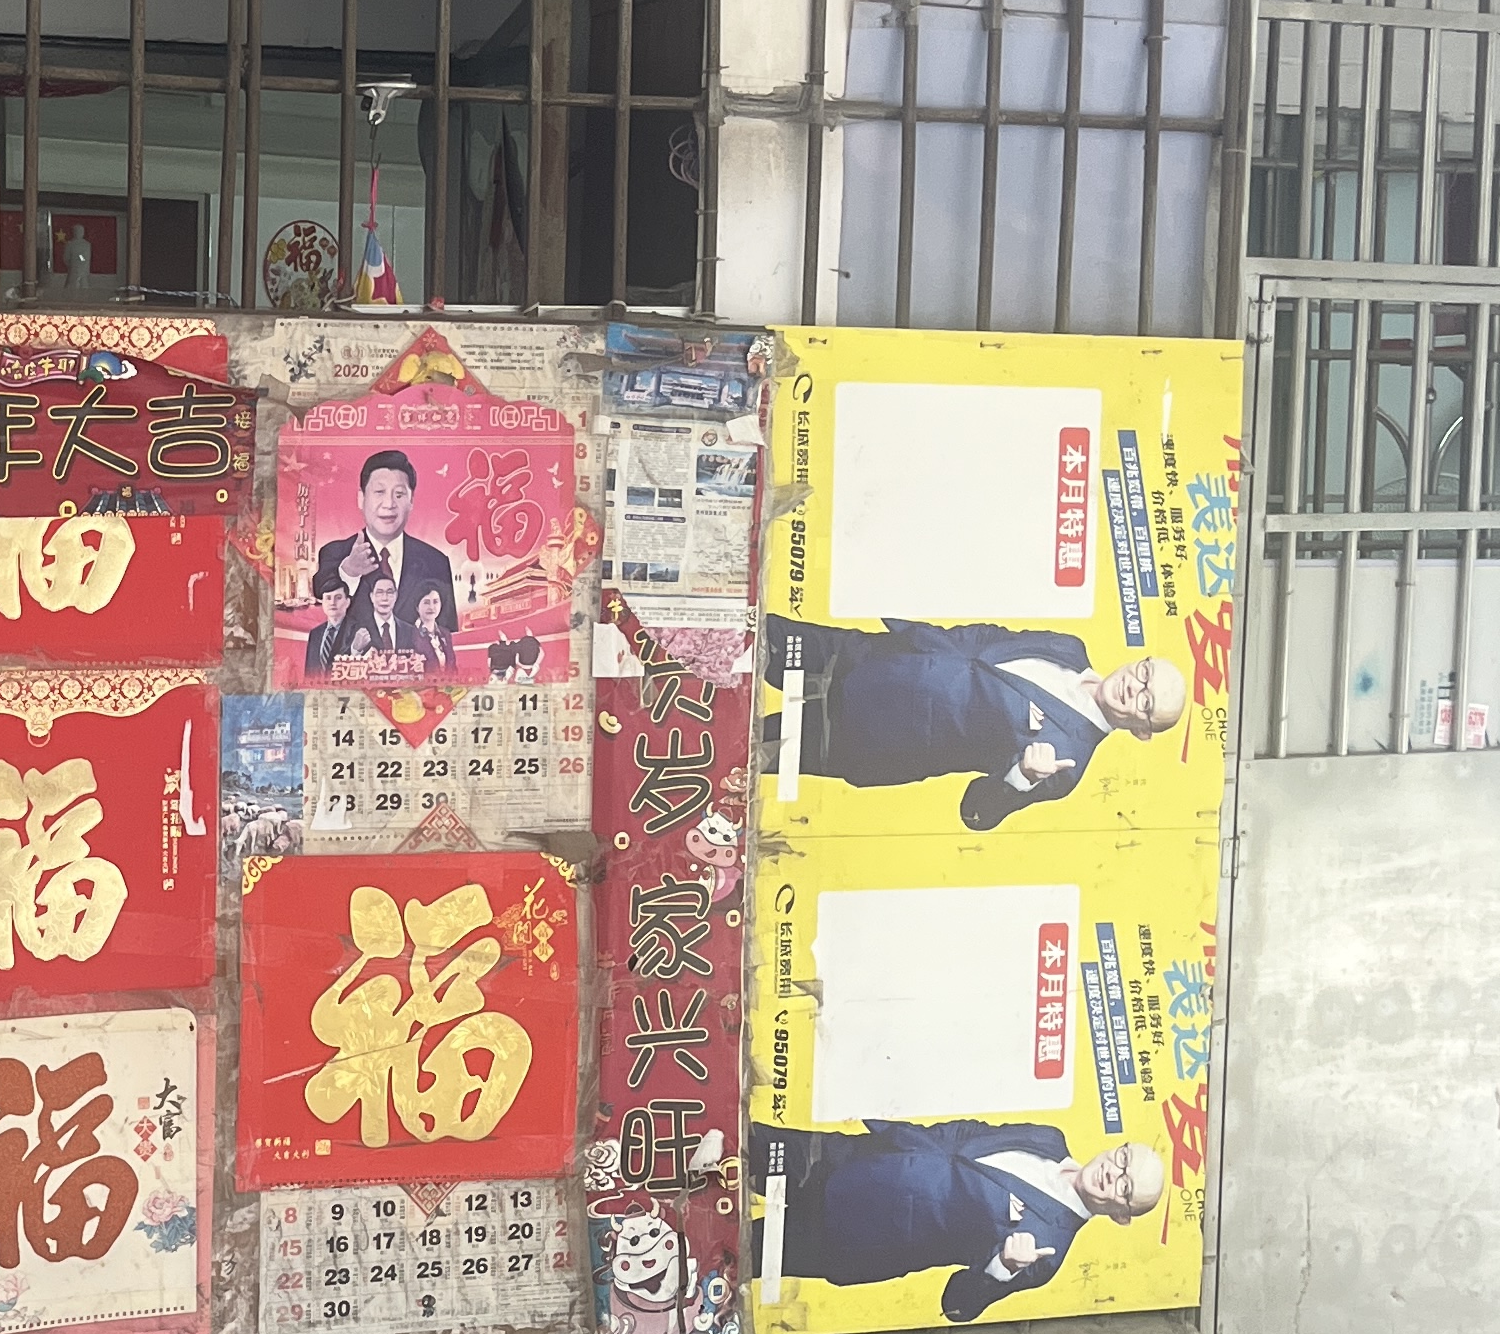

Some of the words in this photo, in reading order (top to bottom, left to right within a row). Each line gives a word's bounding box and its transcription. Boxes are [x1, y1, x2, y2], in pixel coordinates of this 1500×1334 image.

[285, 227, 320, 273] 福
[334, 363, 370, 378] 2020
[574, 443, 587, 460] 8
[444, 446, 545, 561] 福
[1057, 443, 1088, 573] 本月特惠
[789, 519, 806, 582] 95079
[1151, 489, 1179, 616] 价格低、体验爽
[337, 696, 351, 715] 7
[470, 694, 495, 712] 10
[517, 693, 539, 711] 11
[561, 692, 584, 710] 12
[331, 729, 355, 747] 14
[378, 728, 401, 747] 15
[470, 726, 494, 745] 17
[515, 725, 539, 743] 18
[561, 724, 583, 743] 19
[1200, 708, 1218, 742] ONE
[331, 761, 356, 780] 21
[376, 761, 403, 779] 22
[422, 760, 449, 778] 23
[468, 758, 495, 776] 24
[513, 757, 540, 775] 25
[559, 756, 585, 775] 26
[375, 793, 403, 811] 29
[304, 883, 533, 1149] 福
[1038, 939, 1067, 1064] 本月特惠
[1128, 979, 1156, 1103] 价格低、体验爽
[772, 1028, 789, 1090] 95079
[284, 1207, 298, 1224] 8
[331, 1203, 345, 1221] 9
[372, 1200, 396, 1218] 10
[464, 1193, 488, 1212] 12
[509, 1190, 533, 1209] 13
[1180, 1189, 1197, 1222] ONE
[279, 1239, 303, 1257] 15
[325, 1236, 350, 1254] 16
[372, 1232, 396, 1250] 17
[418, 1229, 442, 1247] 18
[463, 1225, 487, 1243] 19
[507, 1222, 534, 1241] 20
[276, 1273, 304, 1290] 22
[323, 1268, 351, 1287] 23
[369, 1264, 397, 1283] 24
[415, 1261, 444, 1279] 25
[461, 1257, 489, 1276] 26
[506, 1253, 534, 1272] 27
[276, 1303, 304, 1323] 29
[322, 1300, 351, 1319] 30
